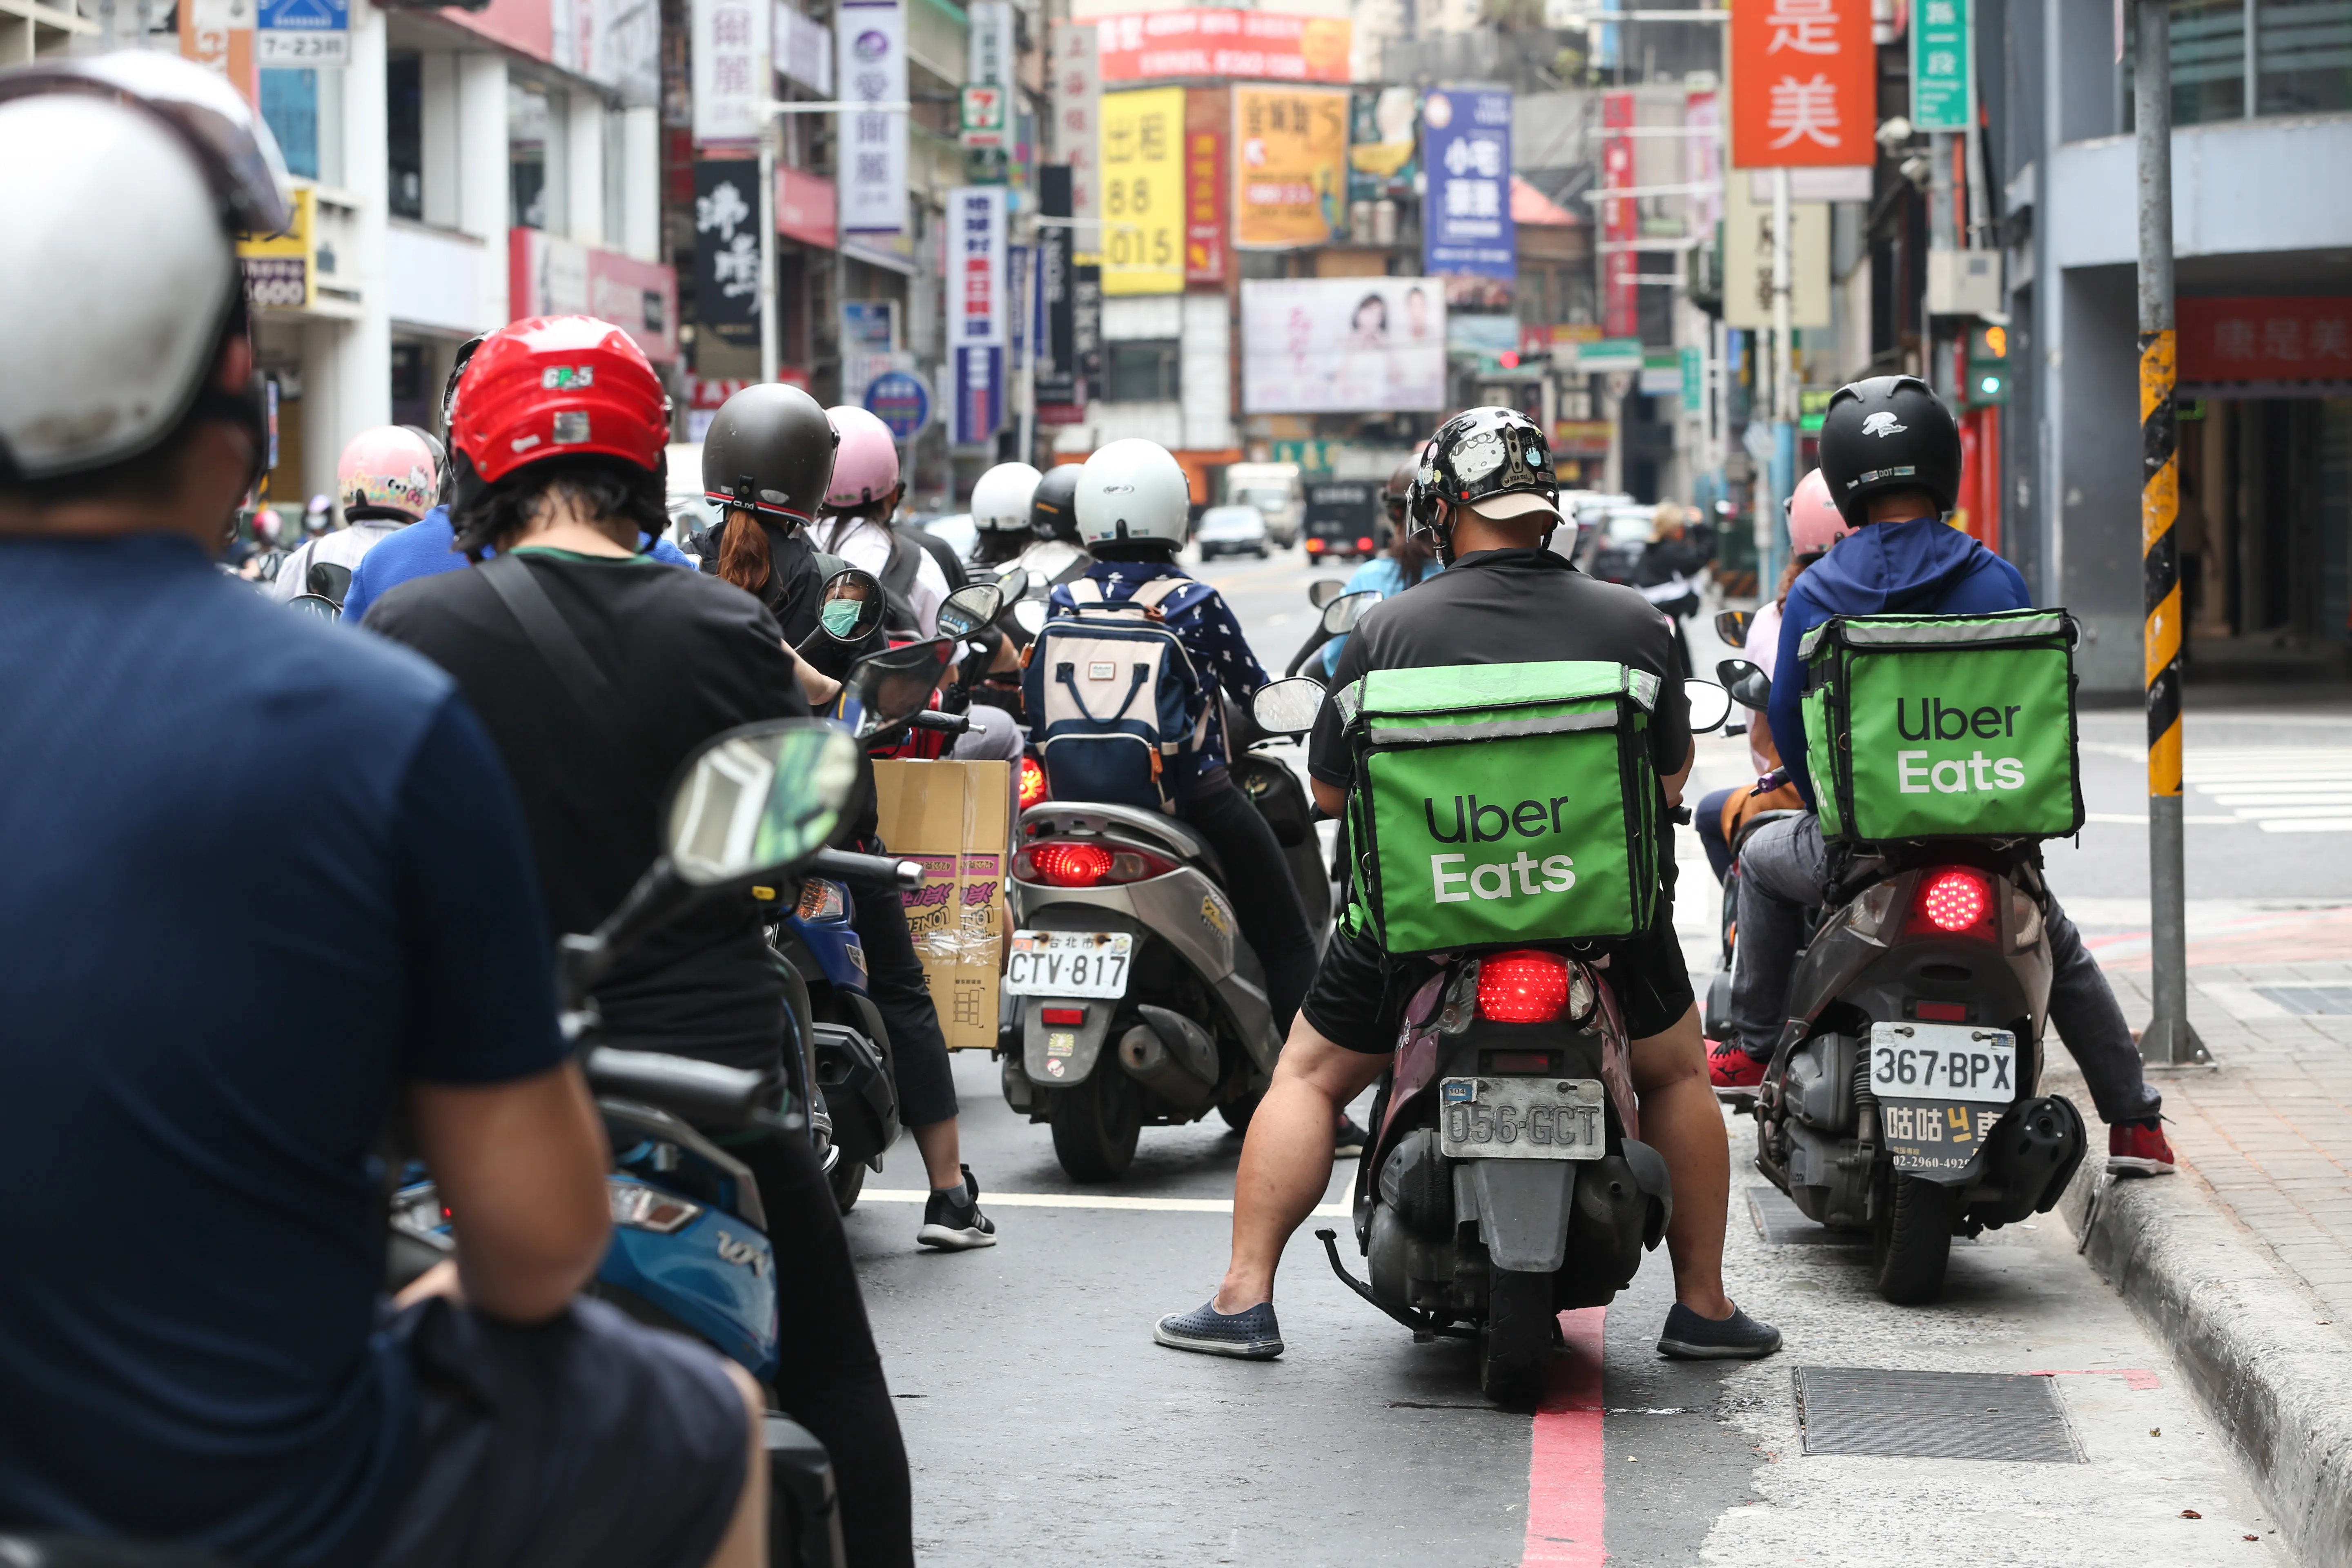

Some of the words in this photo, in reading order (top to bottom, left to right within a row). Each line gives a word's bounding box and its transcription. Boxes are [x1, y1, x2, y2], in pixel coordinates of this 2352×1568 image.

[1765, 0, 1841, 150] 是美
[1879, 469, 1893, 477] DOT
[1897, 697, 2021, 741] Uber
[1898, 750, 2025, 793] Eats
[1424, 794, 1568, 844] Uber
[1430, 851, 1576, 903] Eats
[1049, 936, 1095, 949] 台北市
[1875, 1047, 2010, 1090] 367-BPX
[1446, 1105, 1599, 1145] 056-GCT
